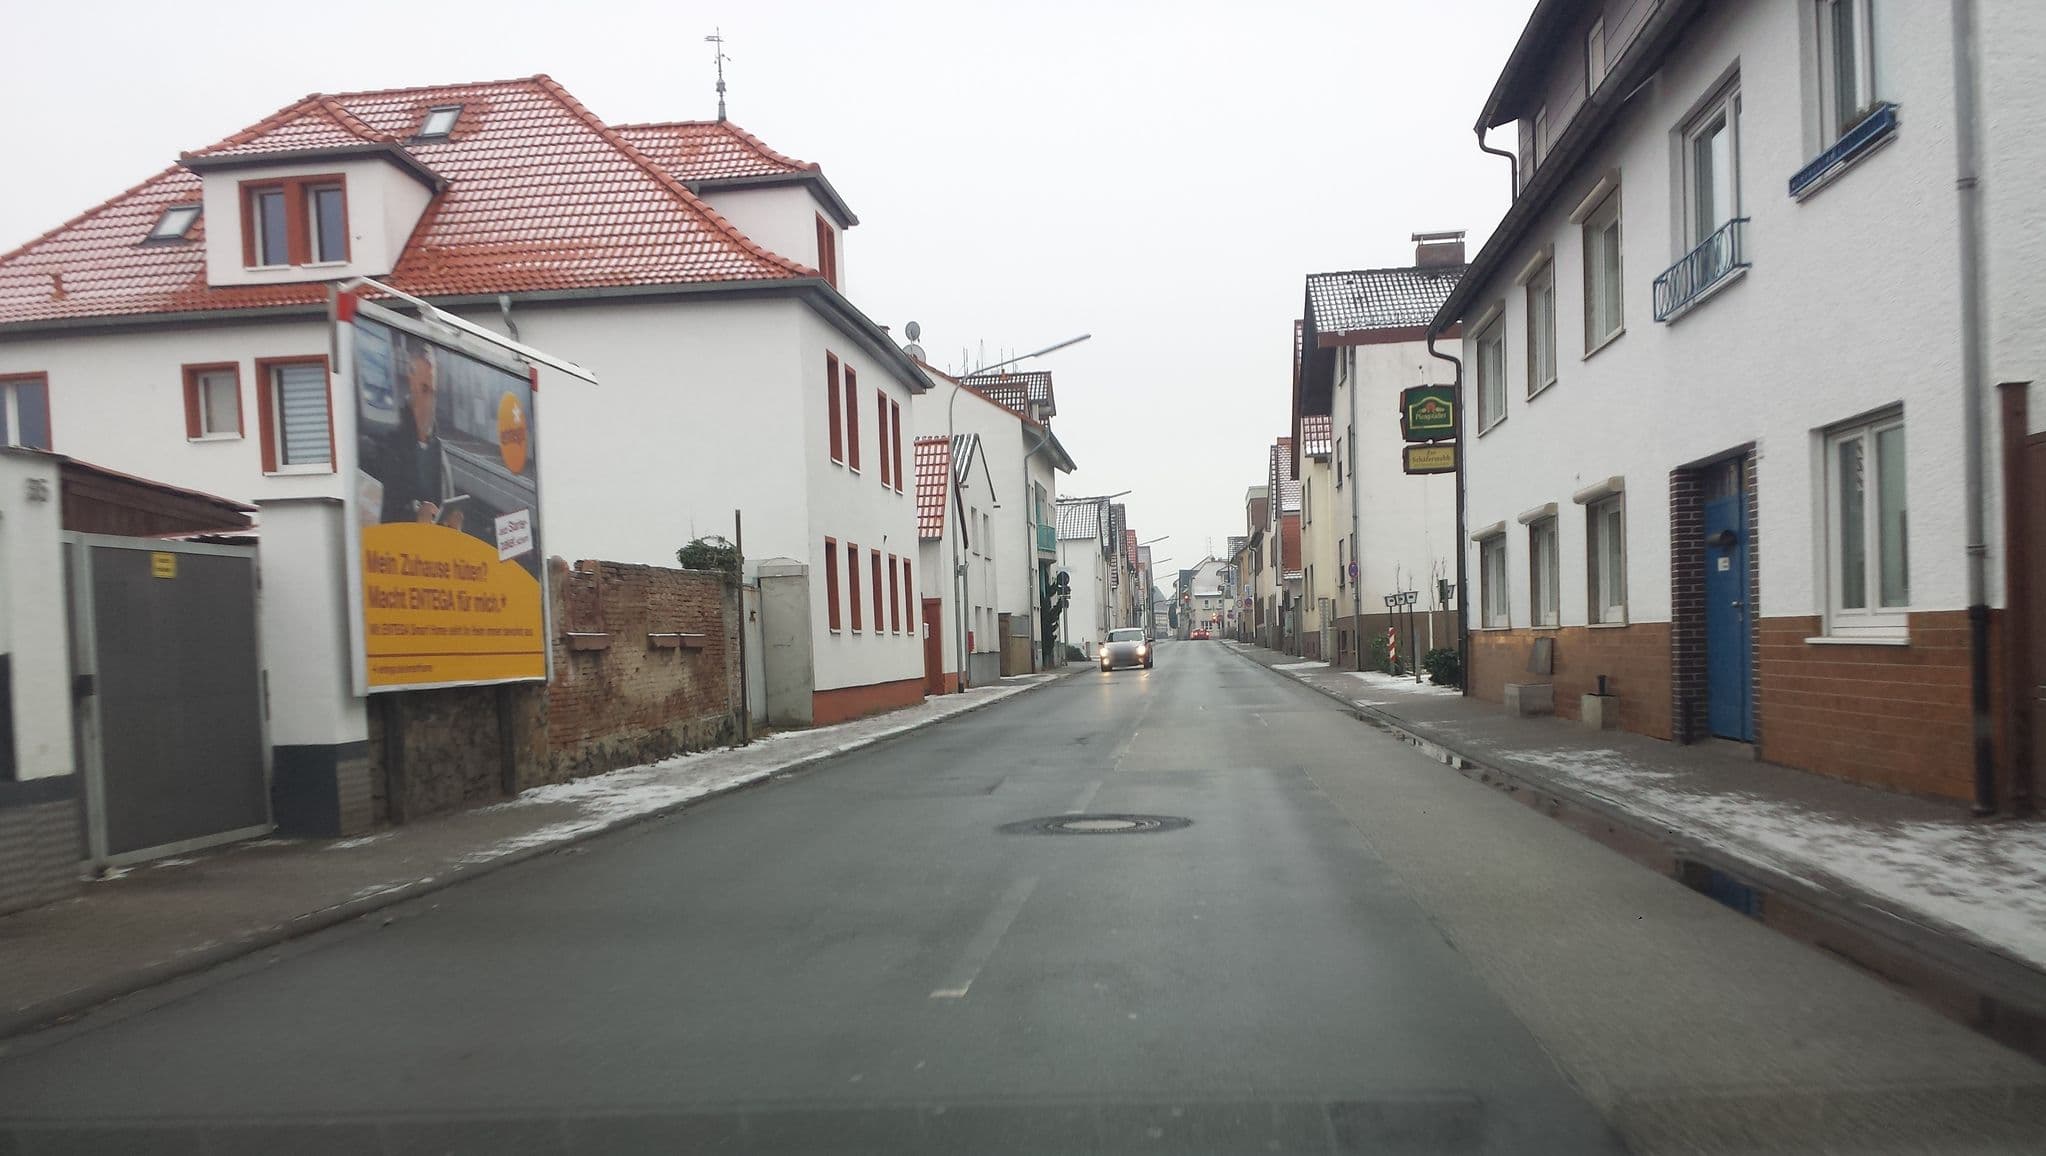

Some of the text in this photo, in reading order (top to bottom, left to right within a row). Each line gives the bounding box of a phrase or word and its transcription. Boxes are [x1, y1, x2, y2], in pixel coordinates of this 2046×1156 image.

[366, 549, 489, 582] Mein Zuhause hüten?
[367, 585, 408, 609] Macht
[409, 586, 455, 611] ENTEGA
[457, 589, 472, 612] für
